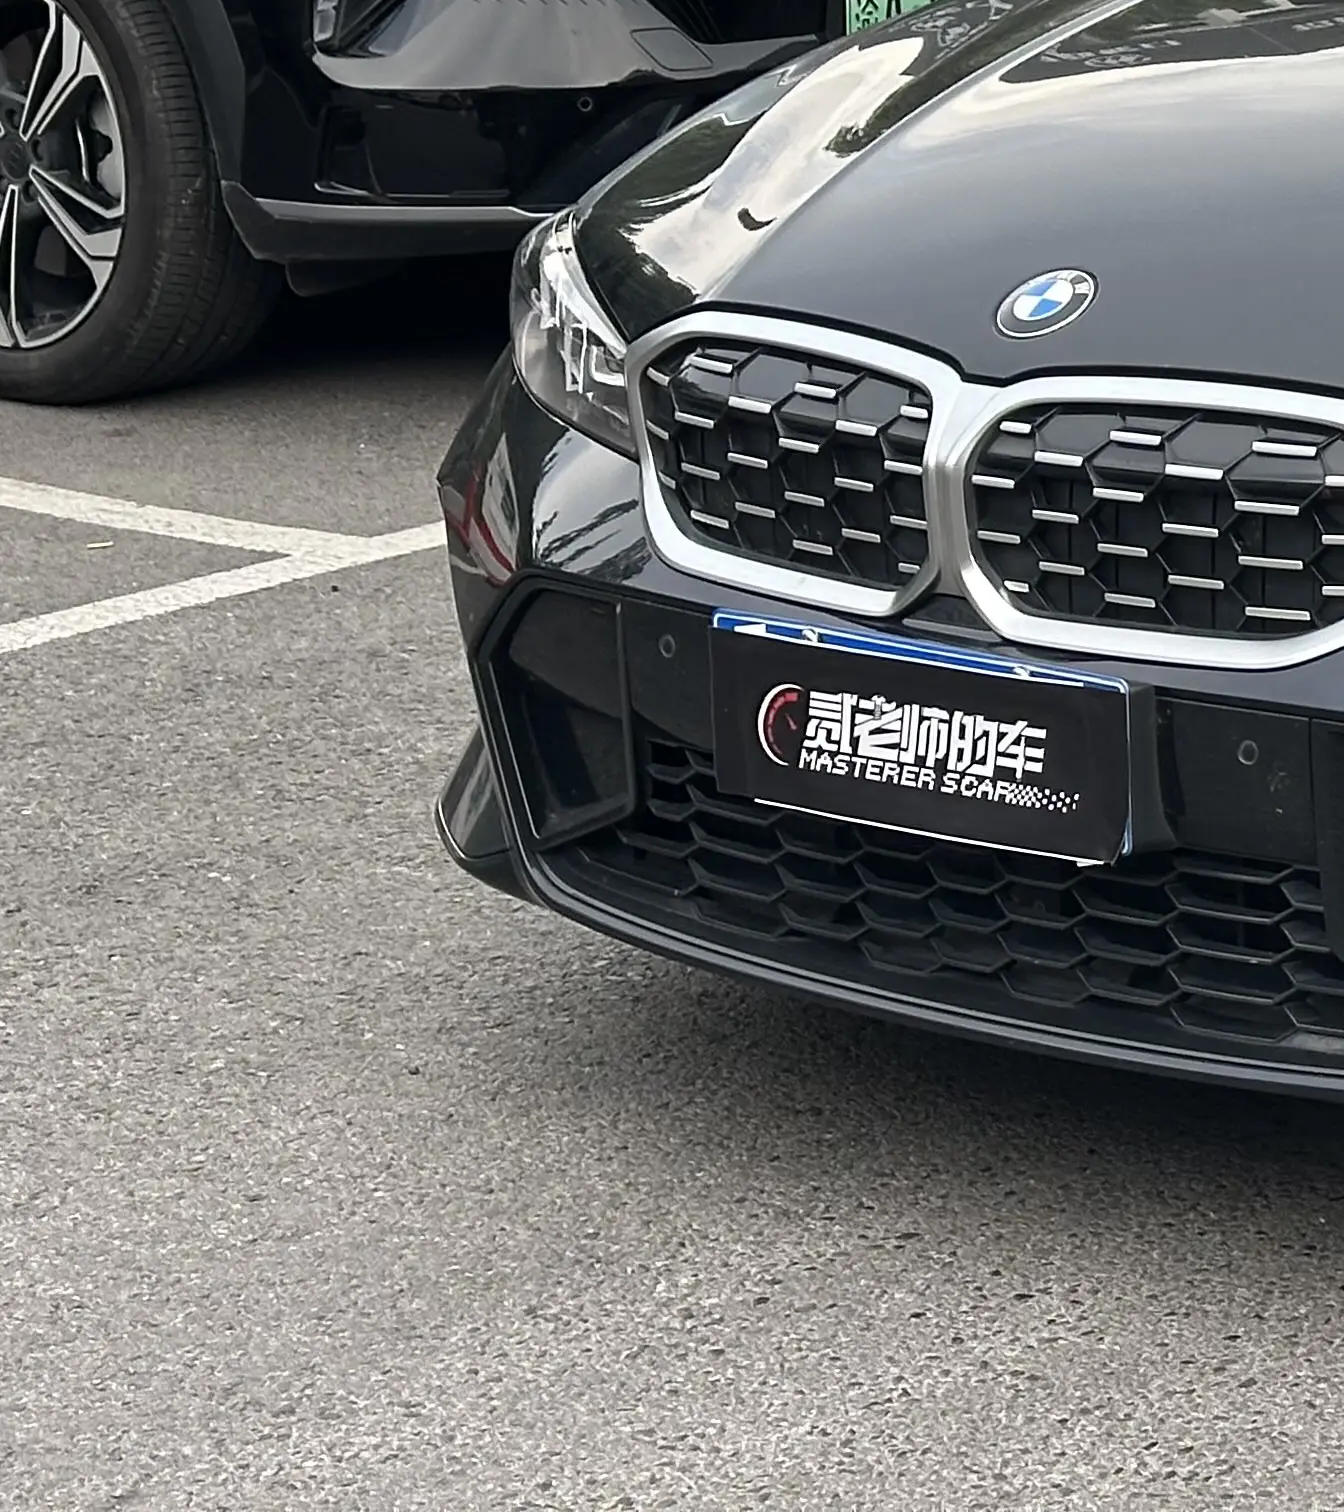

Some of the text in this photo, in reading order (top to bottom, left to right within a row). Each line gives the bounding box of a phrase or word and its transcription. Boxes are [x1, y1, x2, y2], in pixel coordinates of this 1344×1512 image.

[798, 747, 937, 791] MASTERER
[802, 690, 1048, 783] 贰老师的车
